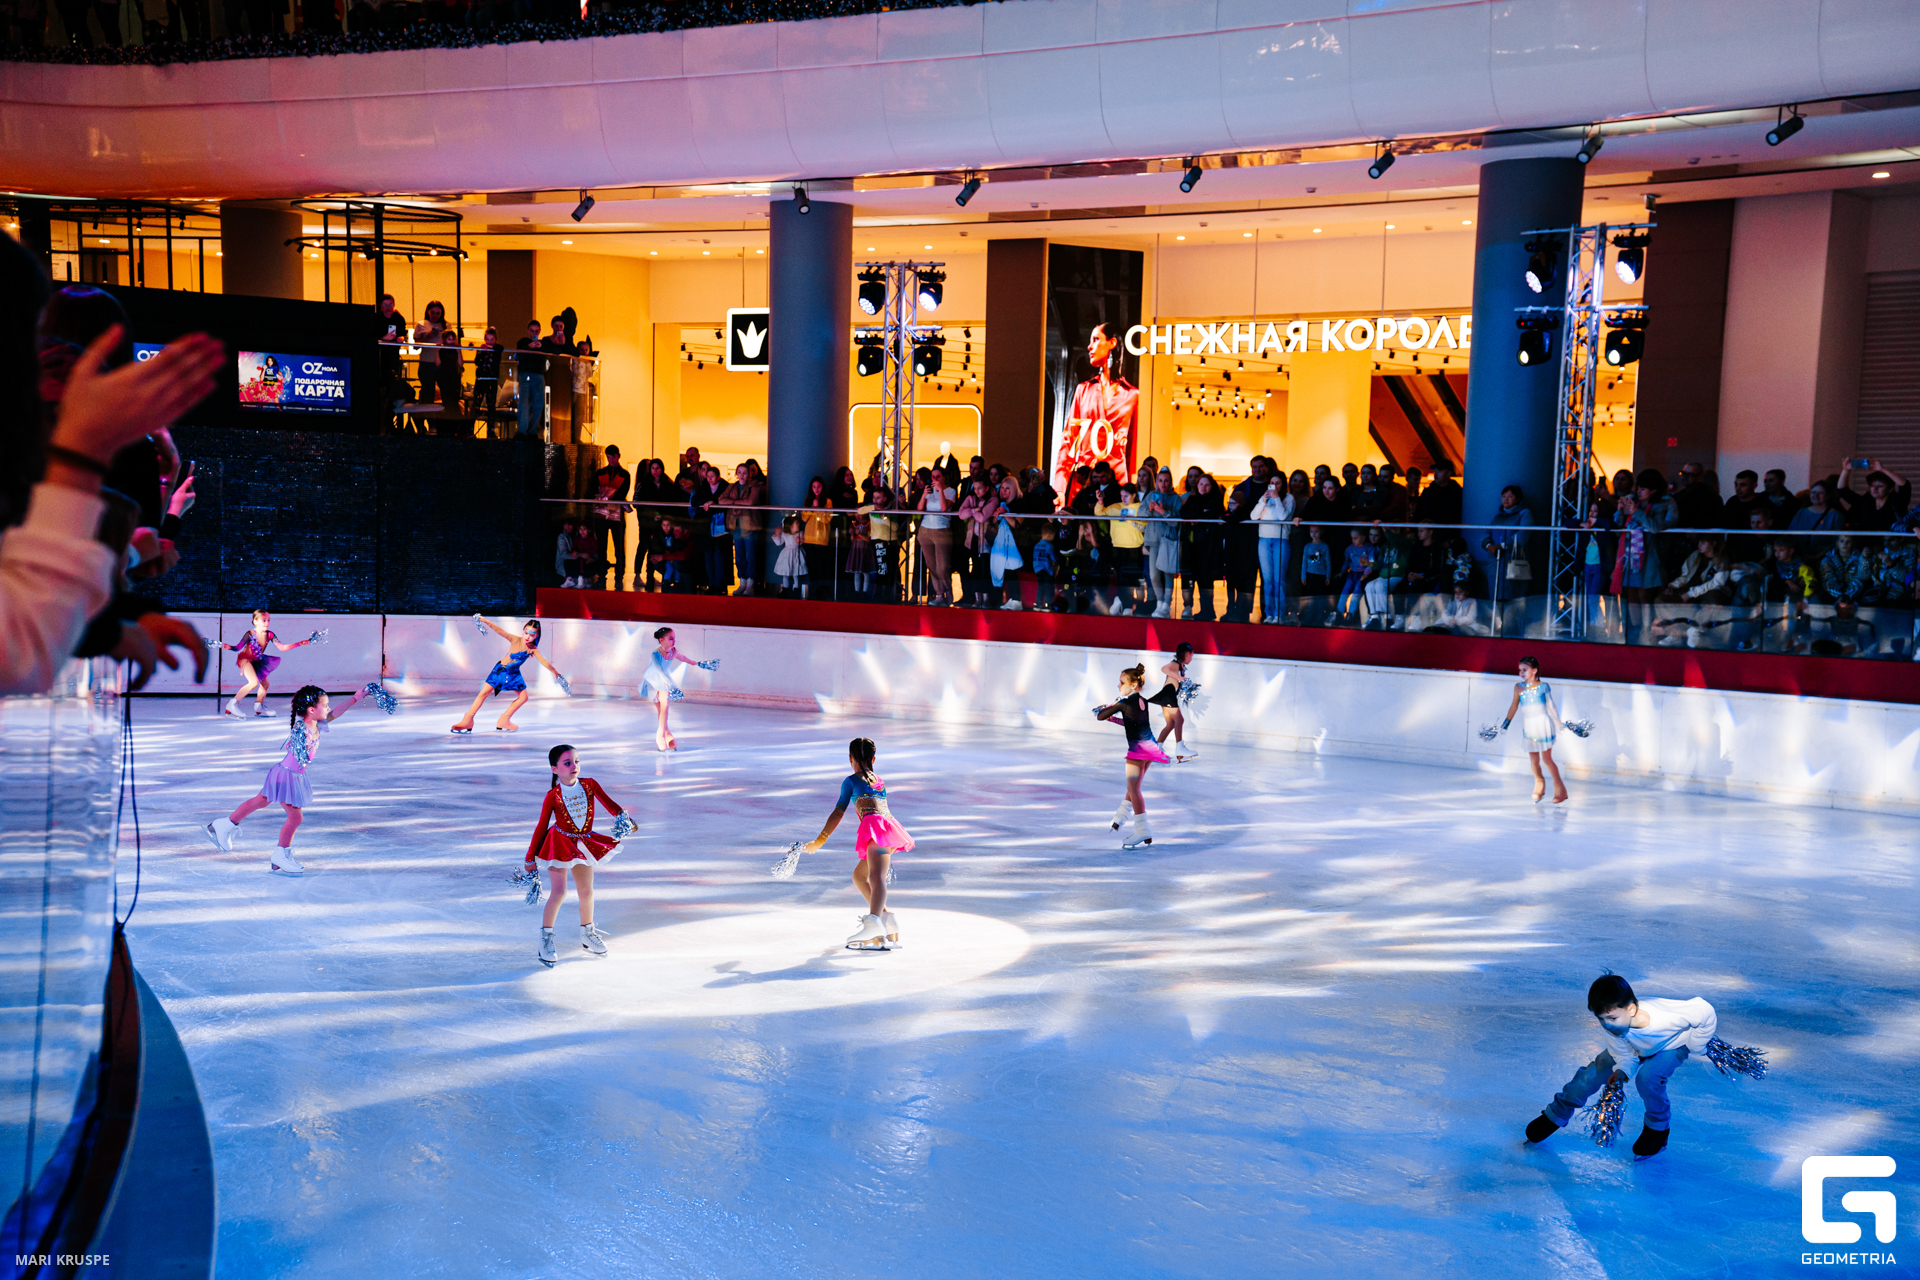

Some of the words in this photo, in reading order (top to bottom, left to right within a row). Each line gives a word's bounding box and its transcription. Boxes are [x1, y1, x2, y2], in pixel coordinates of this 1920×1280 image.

[1125, 321, 1308, 356] СНЕЖНАЯ
[302, 362, 323, 374] OZ
[295, 378, 345, 386] ПОДАРОЧНАЯ
